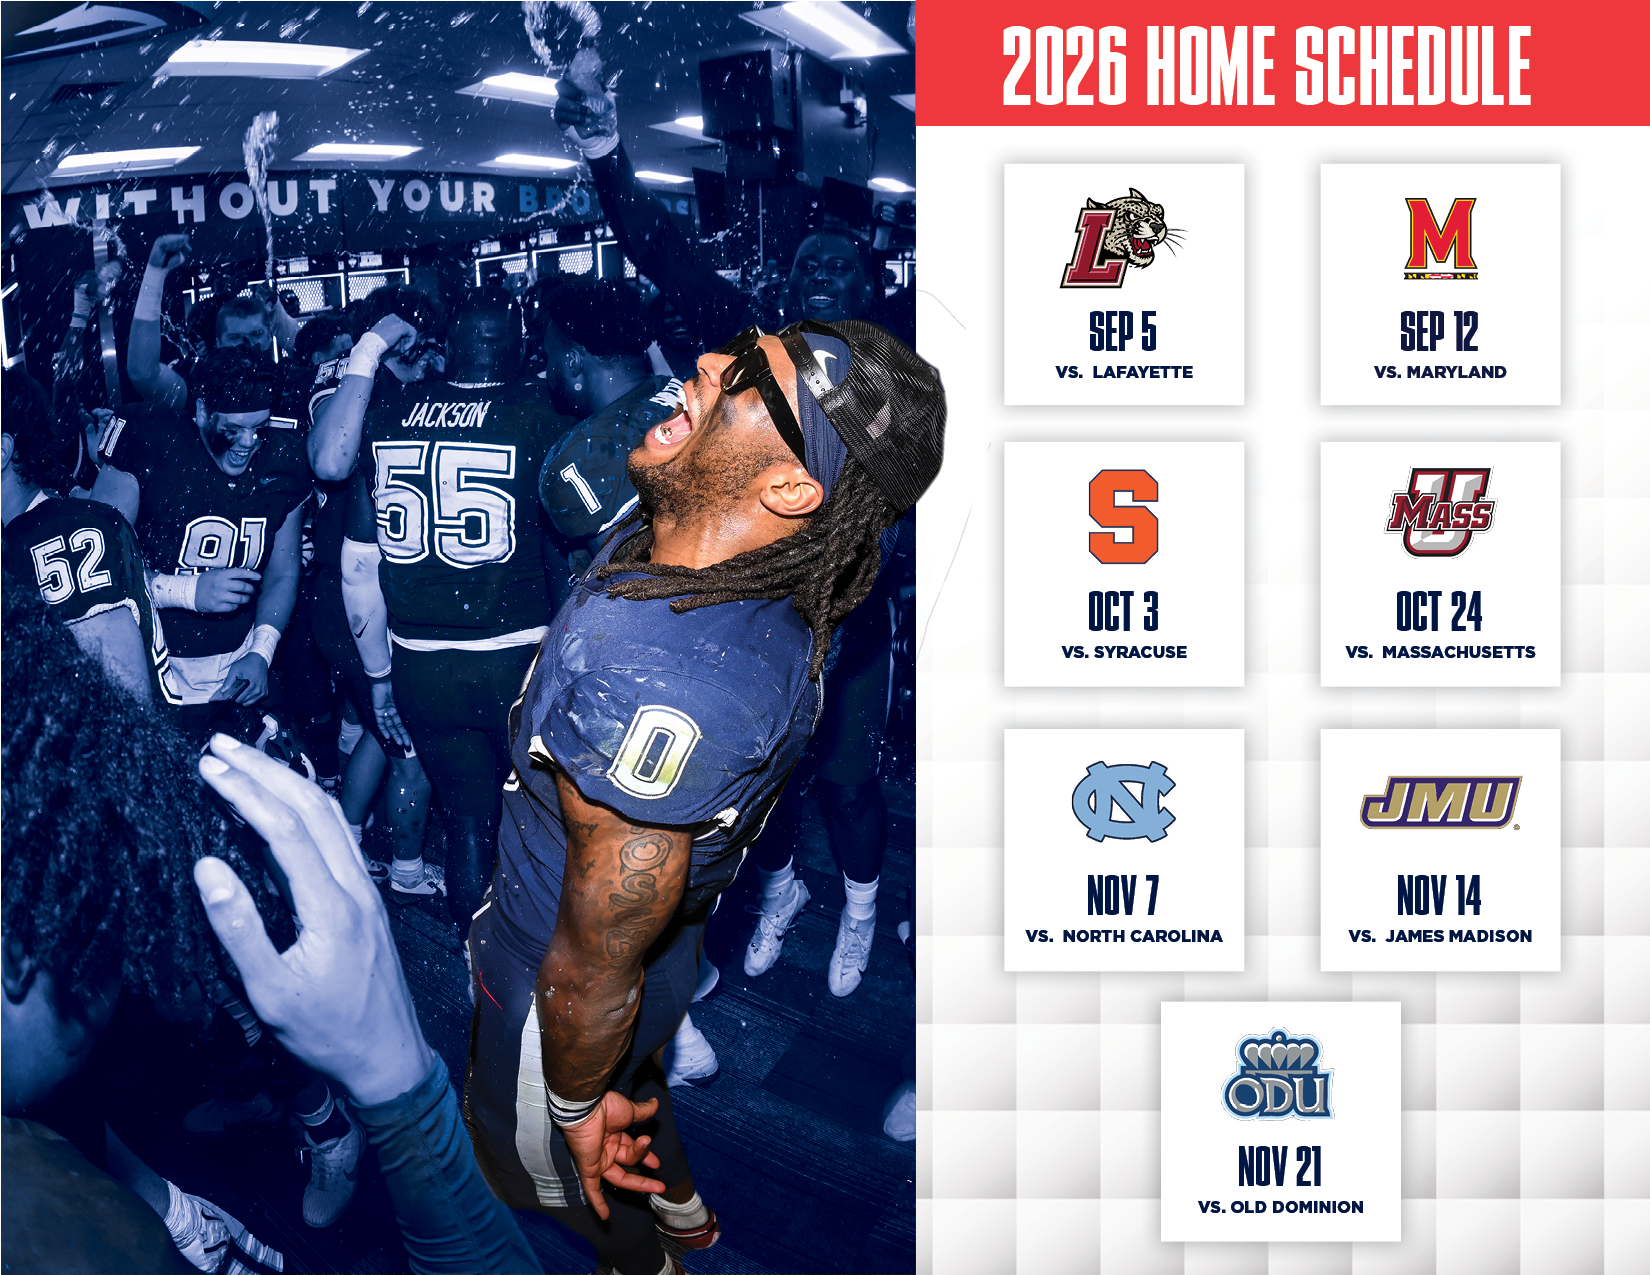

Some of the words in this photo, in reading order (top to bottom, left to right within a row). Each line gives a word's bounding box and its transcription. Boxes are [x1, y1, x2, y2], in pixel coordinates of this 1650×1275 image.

[1004, 26, 1126, 105] 2026
[1147, 26, 1275, 105] HOME
[1296, 26, 1531, 105] SCHEDULE
[366, 178, 495, 214] YOUR
[1405, 197, 1477, 269] M
[1090, 311, 1133, 351] SEP
[1142, 311, 1156, 351] 5
[1401, 311, 1444, 351] SEP
[1454, 311, 1478, 351] 12
[1055, 366, 1083, 378] VS.
[1093, 366, 1193, 378] LAFAYETTE
[1374, 366, 1401, 378] VS.
[1407, 366, 1507, 378] MARYLAND
[402, 401, 491, 428] JACKSON
[372, 440, 516, 569] 55
[560, 462, 602, 515] 1
[1088, 469, 1159, 564] S
[30, 527, 112, 604] 52
[1089, 591, 1134, 631] OCT
[1144, 591, 1158, 631] 3
[1397, 591, 1442, 631] OCT
[1452, 591, 1482, 631] 24
[1061, 646, 1089, 658] VS.
[1094, 646, 1187, 658] SYRACUSE
[1345, 646, 1373, 658] VS.
[1383, 646, 1536, 658] MASSACHUSETTS
[606, 704, 703, 800] 0
[1358, 775, 1524, 830] JMU
[1088, 875, 1137, 915] NOV
[1146, 875, 1159, 915] 7
[1398, 875, 1447, 915] NOV
[1456, 875, 1481, 915] 14
[1025, 930, 1053, 942] VS.
[1063, 930, 1125, 942] NORTH
[1130, 930, 1223, 942] CAROLINA
[1348, 930, 1376, 942] VS.
[1386, 930, 1444, 942] JAMES
[1449, 930, 1532, 942] MADISON
[1225, 1074, 1334, 1120] ODU
[1239, 1146, 1288, 1186] NOV
[1297, 1146, 1321, 1186] 21
[1198, 1201, 1226, 1213] VS.
[1231, 1201, 1267, 1213] OLD
[1273, 1201, 1363, 1213] DOMINION
